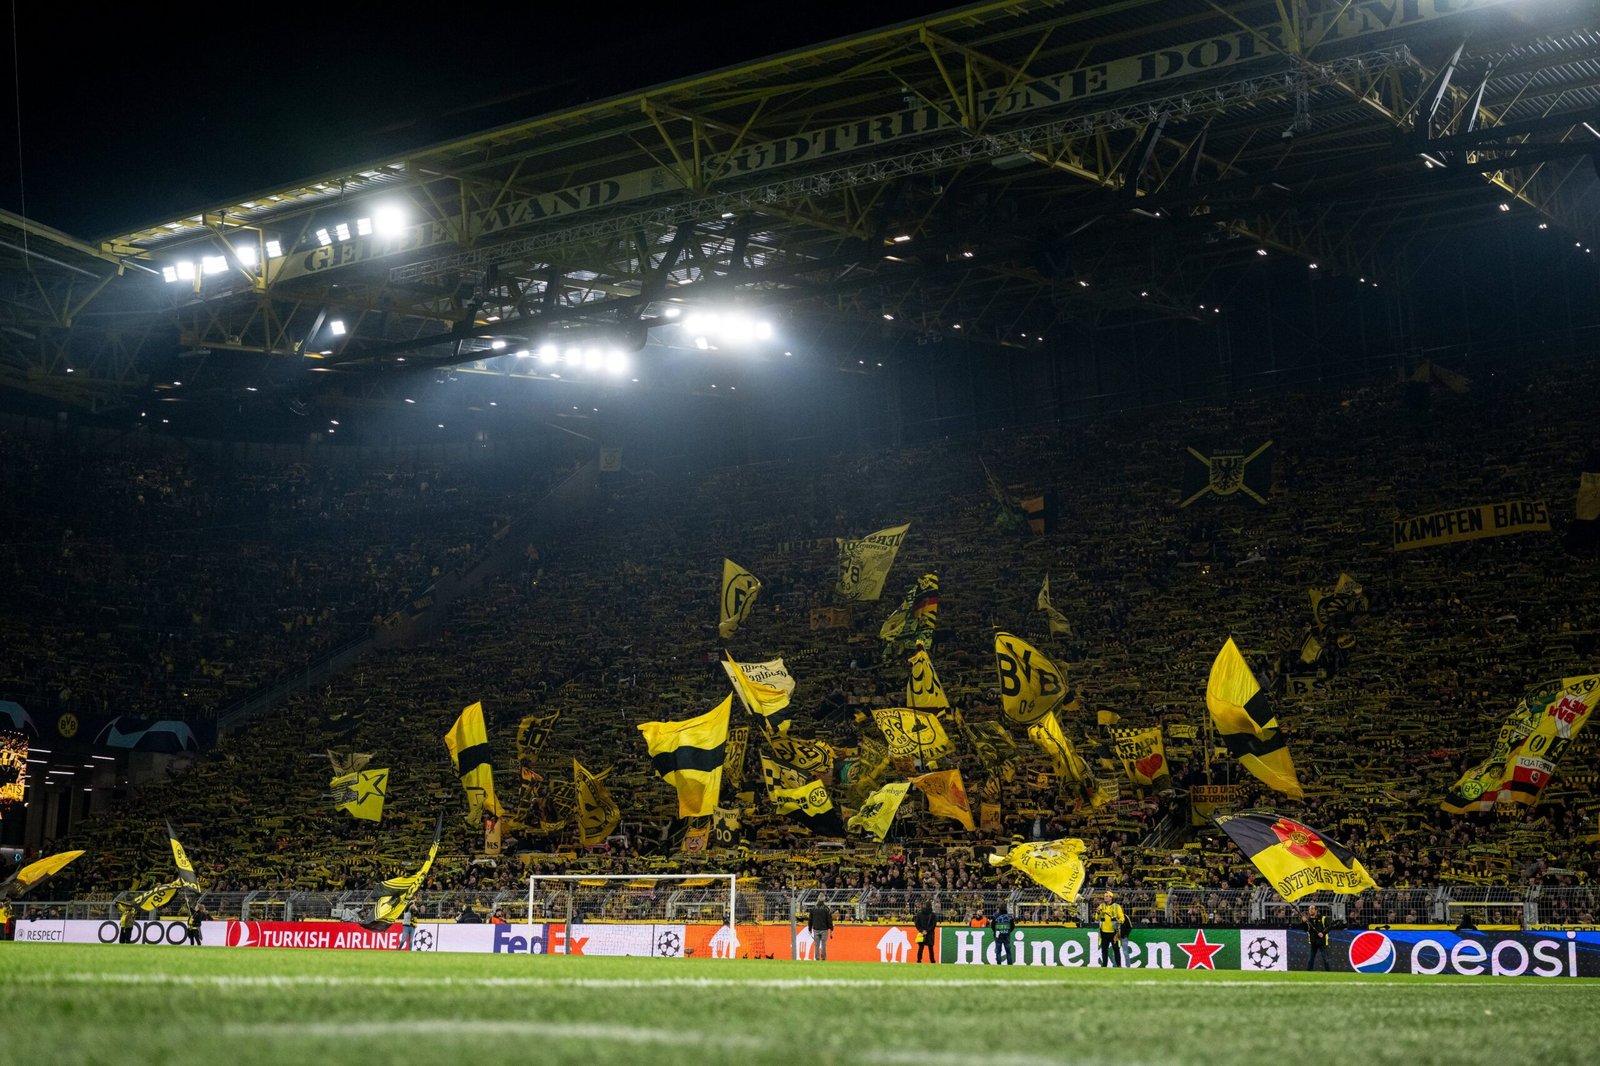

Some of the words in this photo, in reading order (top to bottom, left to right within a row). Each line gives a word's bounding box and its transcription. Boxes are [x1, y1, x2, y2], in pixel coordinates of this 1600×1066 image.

[477, 181, 620, 231] WAND
[1137, 0, 1468, 82] DORTM
[996, 642, 1060, 696] BVB
[61, 715, 76, 730] BVB
[810, 790, 826, 803] BVB
[27, 930, 62, 942] RESPECT
[264, 930, 331, 948] TURKISH
[334, 931, 406, 949] AIRLINES
[493, 924, 589, 956] FedEx
[1411, 930, 1577, 977] pepsi
